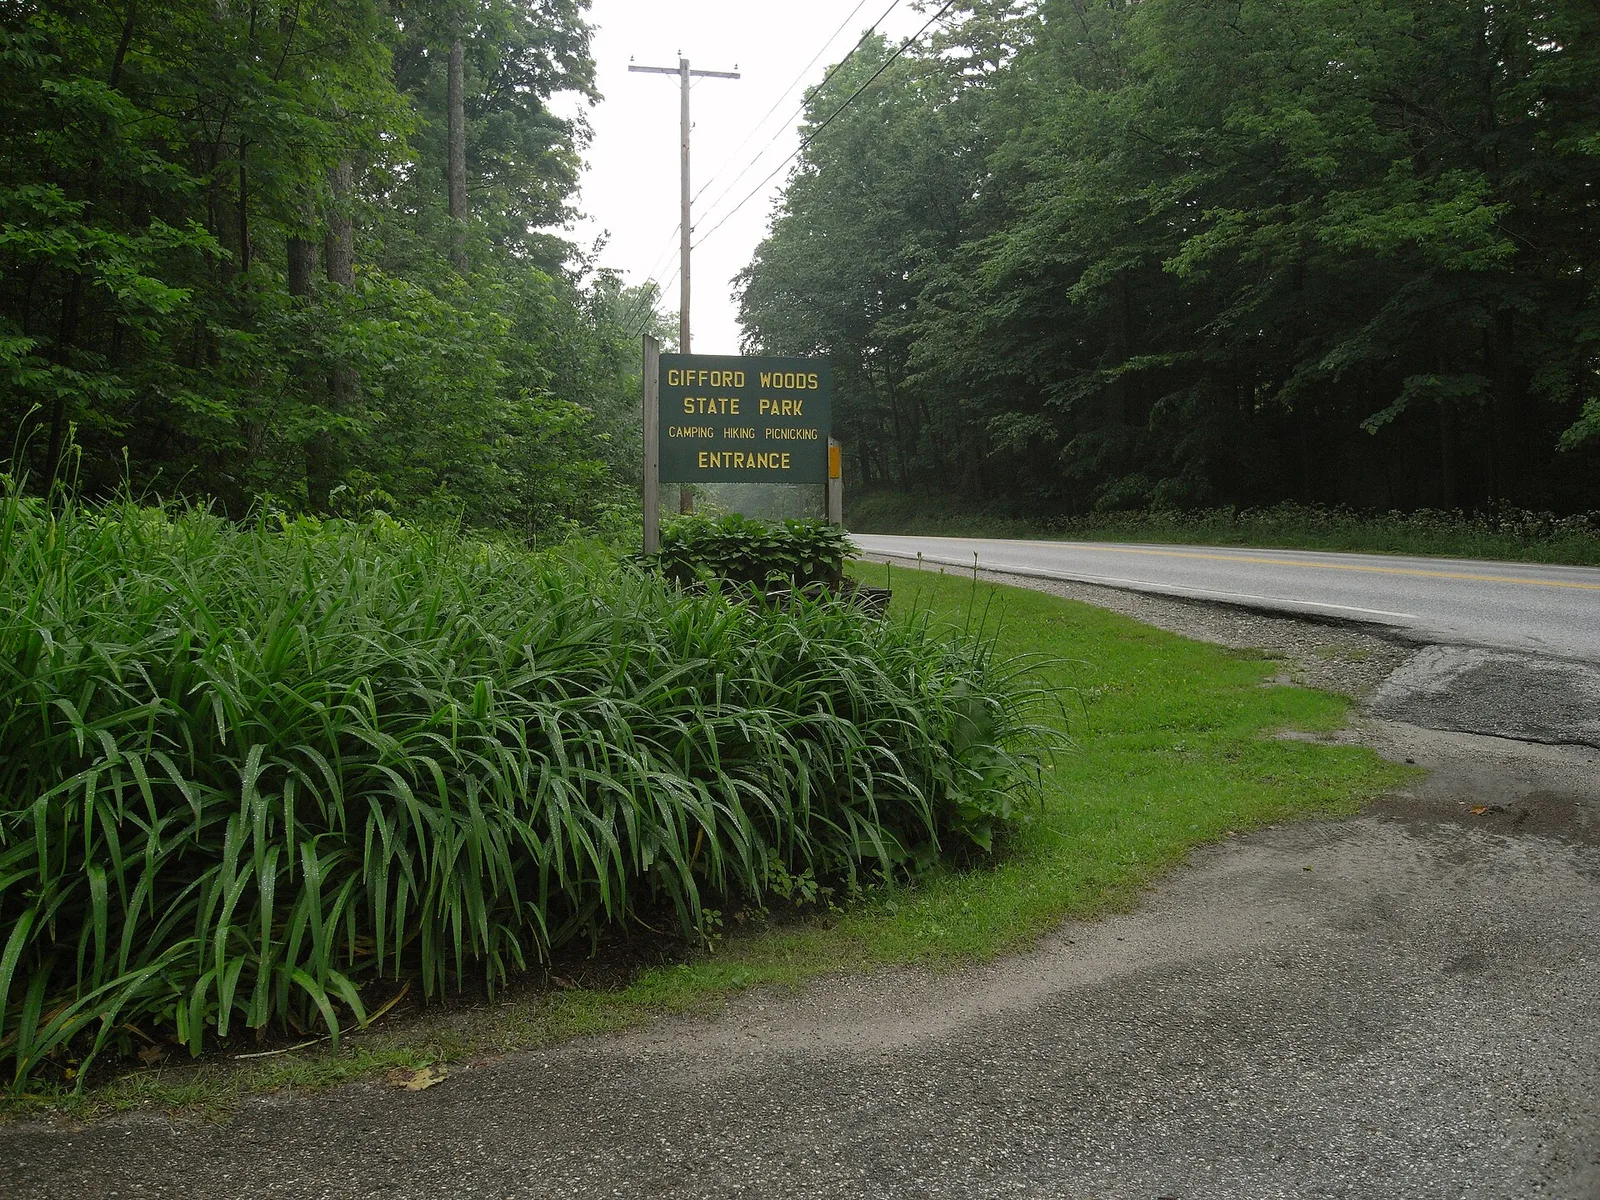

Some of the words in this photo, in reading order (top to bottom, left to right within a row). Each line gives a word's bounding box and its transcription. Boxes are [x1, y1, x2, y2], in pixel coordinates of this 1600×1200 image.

[668, 369, 745, 388] GIFFORD
[759, 371, 818, 390] WOODS
[683, 397, 740, 415] STATE
[759, 399, 803, 416] PARK
[668, 426, 714, 438] CAMPING
[723, 427, 755, 439] HIKING
[765, 428, 818, 440] PICNICKING
[698, 451, 790, 469] ENTRANCE
